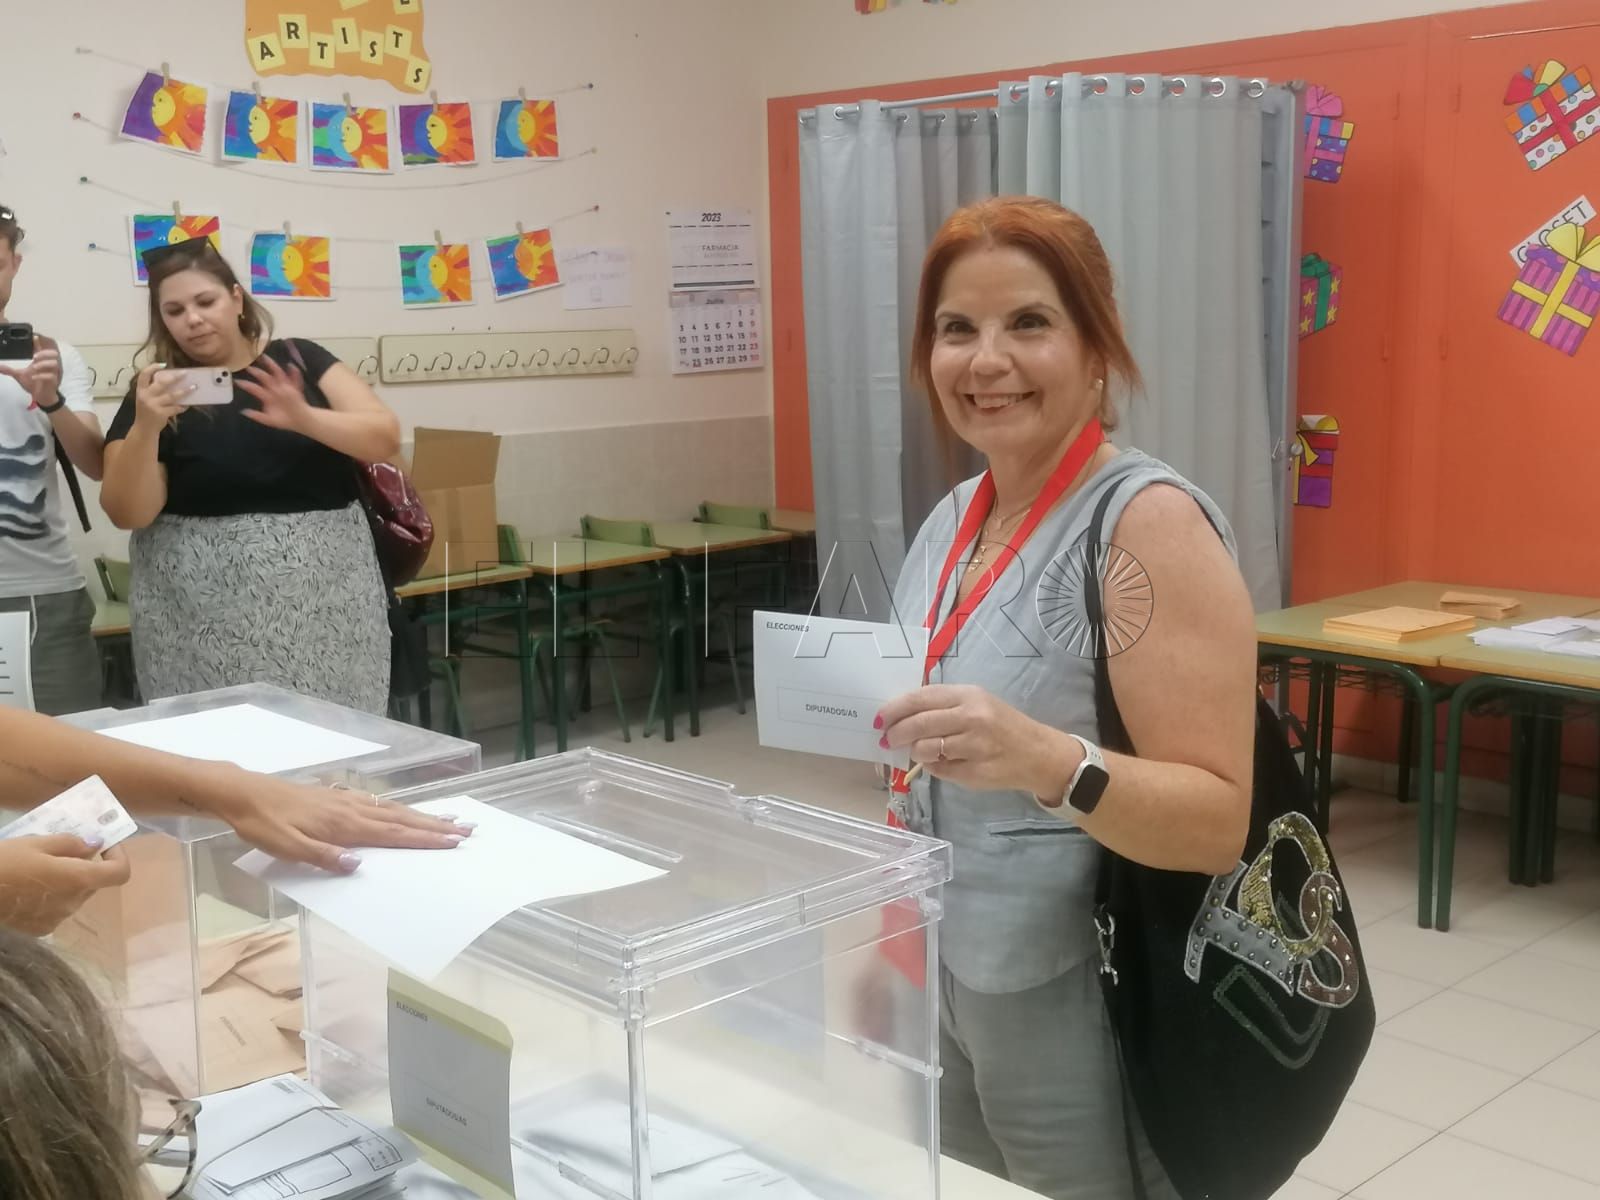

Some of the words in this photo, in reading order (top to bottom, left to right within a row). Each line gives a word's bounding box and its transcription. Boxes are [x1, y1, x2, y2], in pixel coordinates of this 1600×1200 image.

[259, 22, 423, 83] ARTISTS
[701, 213, 721, 222] 2023
[1517, 201, 1587, 263] COET
[704, 334, 711, 342] 12
[714, 333, 722, 341] 13
[767, 621, 809, 632] ELECCIONES
[806, 703, 858, 718] DIPUTADOS/AS
